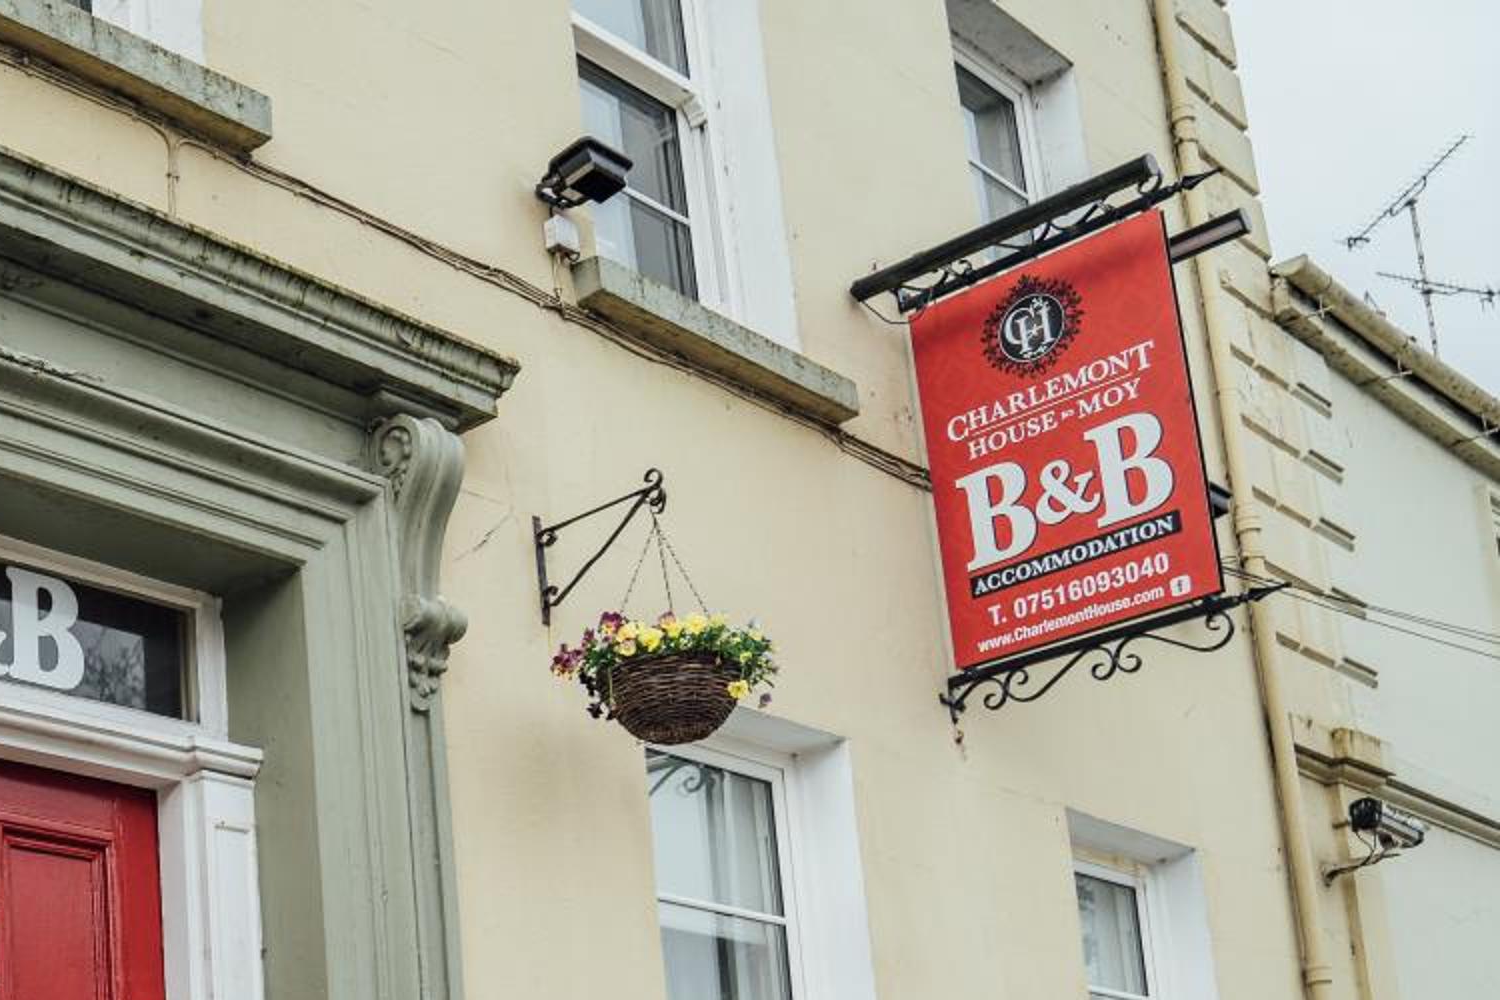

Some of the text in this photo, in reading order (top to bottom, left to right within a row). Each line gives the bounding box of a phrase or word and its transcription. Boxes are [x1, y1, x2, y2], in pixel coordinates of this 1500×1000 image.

[947, 340, 1155, 442] CHARLEMONT
[968, 378, 1140, 461] HOUSE MOY
[955, 412, 1174, 572] B&B
[974, 515, 1173, 595] ACCOMMODATION
[988, 552, 1170, 626] T. 07516093040
[977, 587, 1165, 653] www.CharlemontHouse.com
